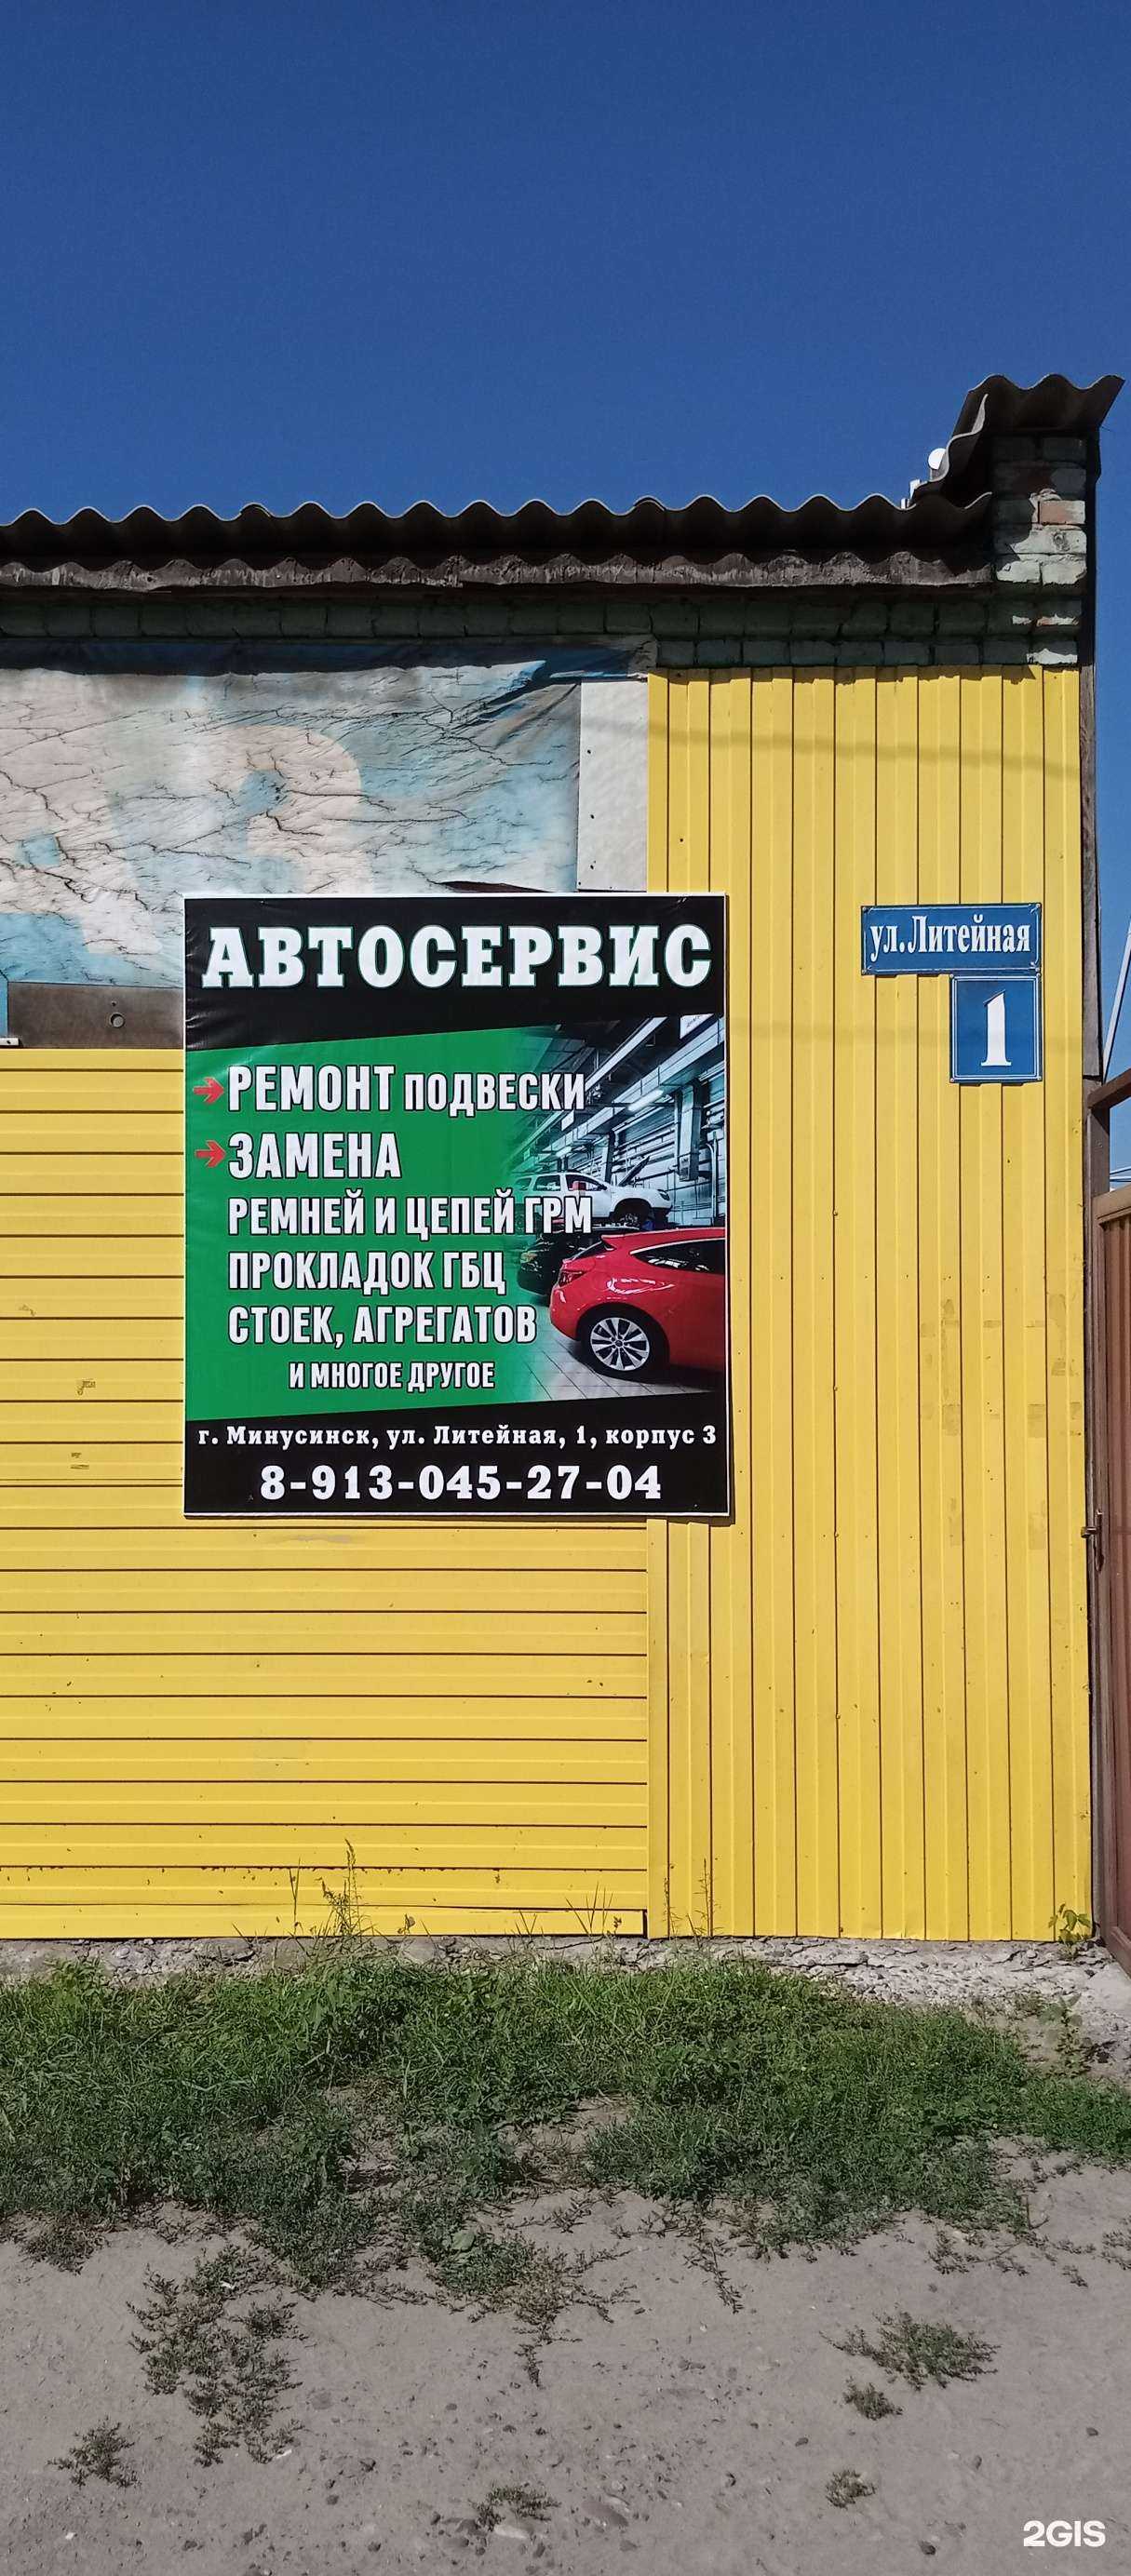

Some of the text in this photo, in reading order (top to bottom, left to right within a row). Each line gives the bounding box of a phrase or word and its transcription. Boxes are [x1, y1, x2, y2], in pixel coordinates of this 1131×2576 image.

[201, 924, 713, 988] АВТОСЕРВИС
[869, 914, 1031, 962] ул.Литейная
[980, 989, 1012, 1067] 1
[227, 1064, 586, 1117] РЕМОНТ ПОДВЕСКИ
[227, 1132, 401, 1178] ЗАМЕНА
[227, 1188, 593, 1241] РЕМНЕЙ И ЦЕПЕЙ ГРМ
[227, 1251, 506, 1296] ПРОКЛАДОК ГБЦ
[227, 1305, 537, 1349] СТОЕК, АГРЕГАТОВ
[289, 1362, 494, 1392] И МНОГОЕ ДРУГОЕ
[198, 1425, 717, 1450] г. Минусинск, ул. Литейная, 1, корпус 3
[260, 1464, 662, 1500] 8-913-045-27-04
